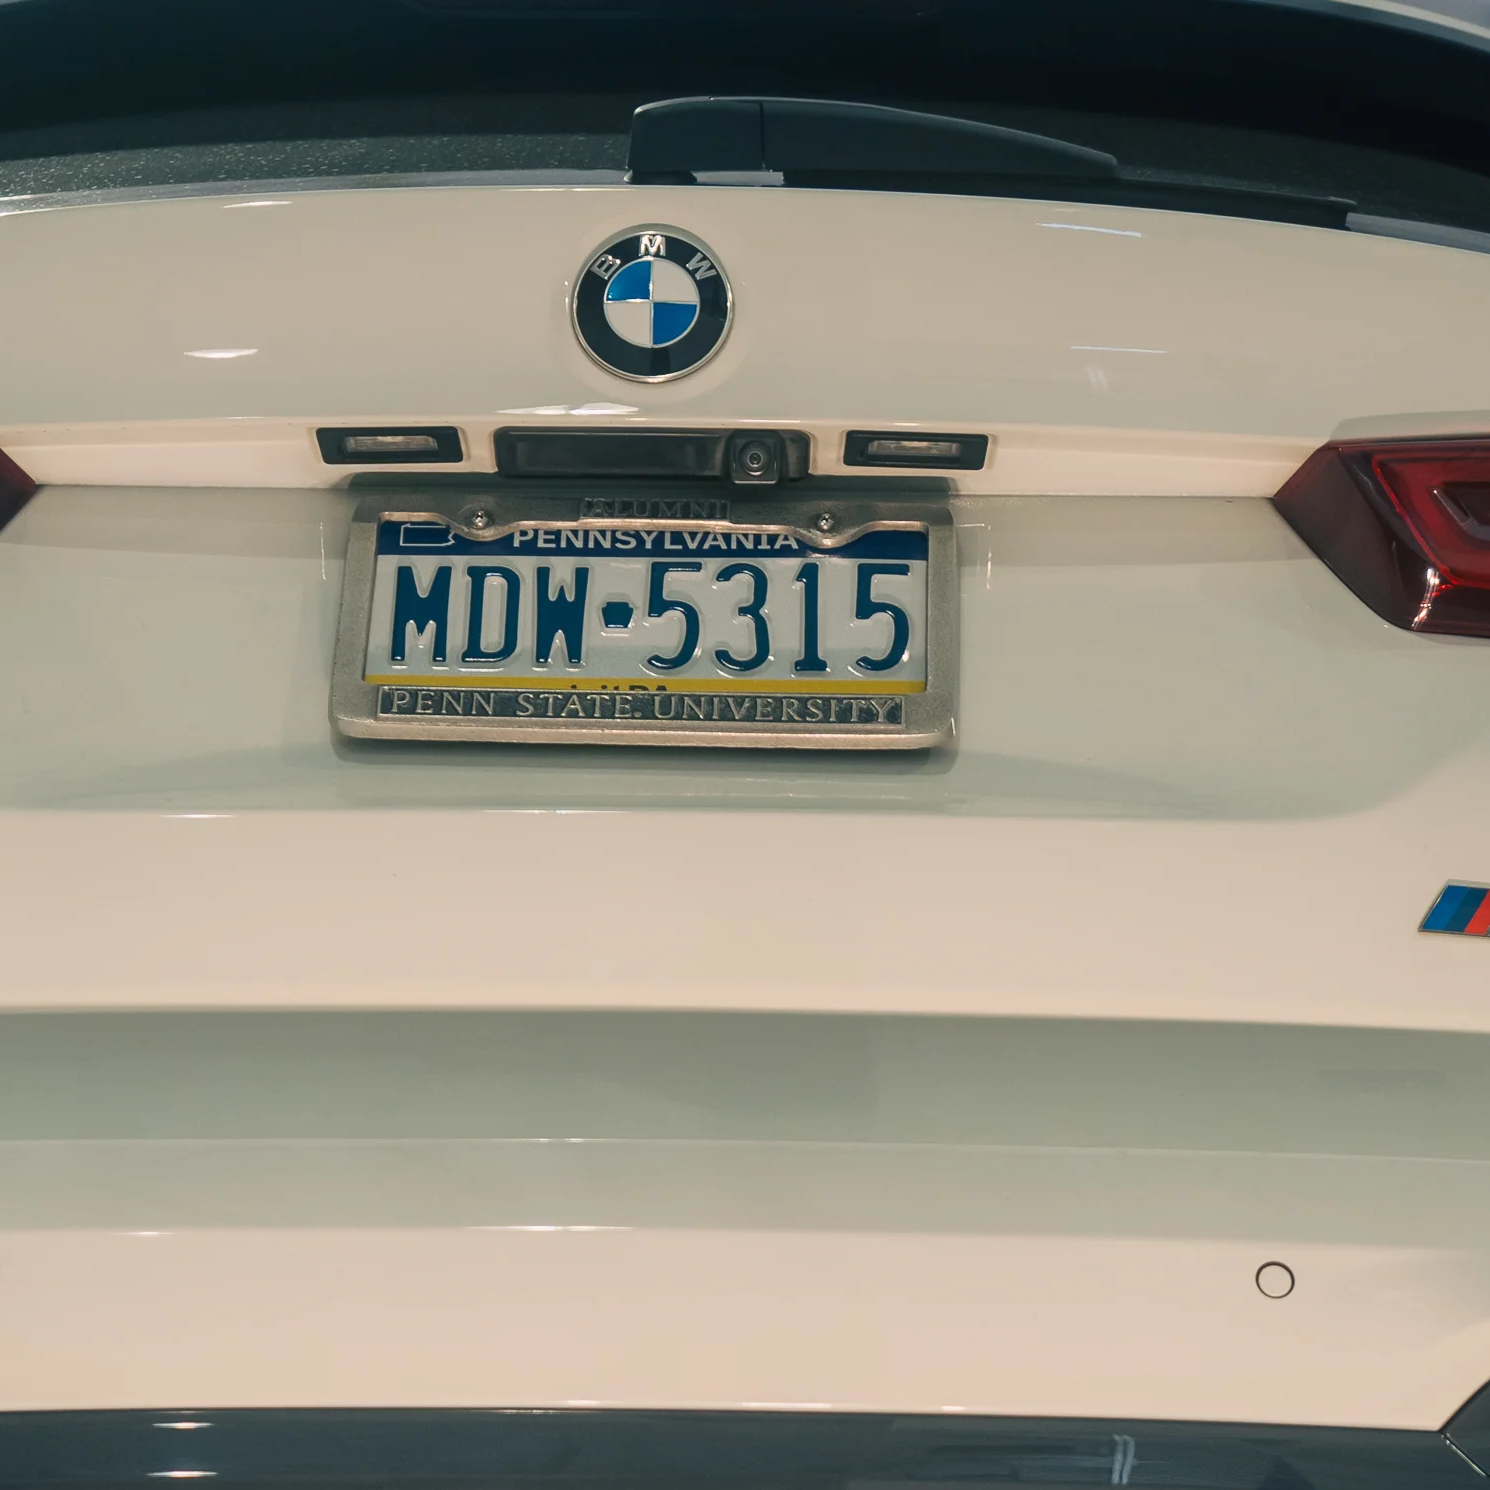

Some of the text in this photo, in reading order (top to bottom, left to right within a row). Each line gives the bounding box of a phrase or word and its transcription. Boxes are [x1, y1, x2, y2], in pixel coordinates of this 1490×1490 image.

[590, 235, 717, 280] BMW
[589, 499, 723, 518] ALUMNI
[512, 528, 799, 549] PENNSYLVANIA
[391, 561, 910, 671] MDW 5315
[391, 689, 896, 722] PENN STATE UNIVERSITY
